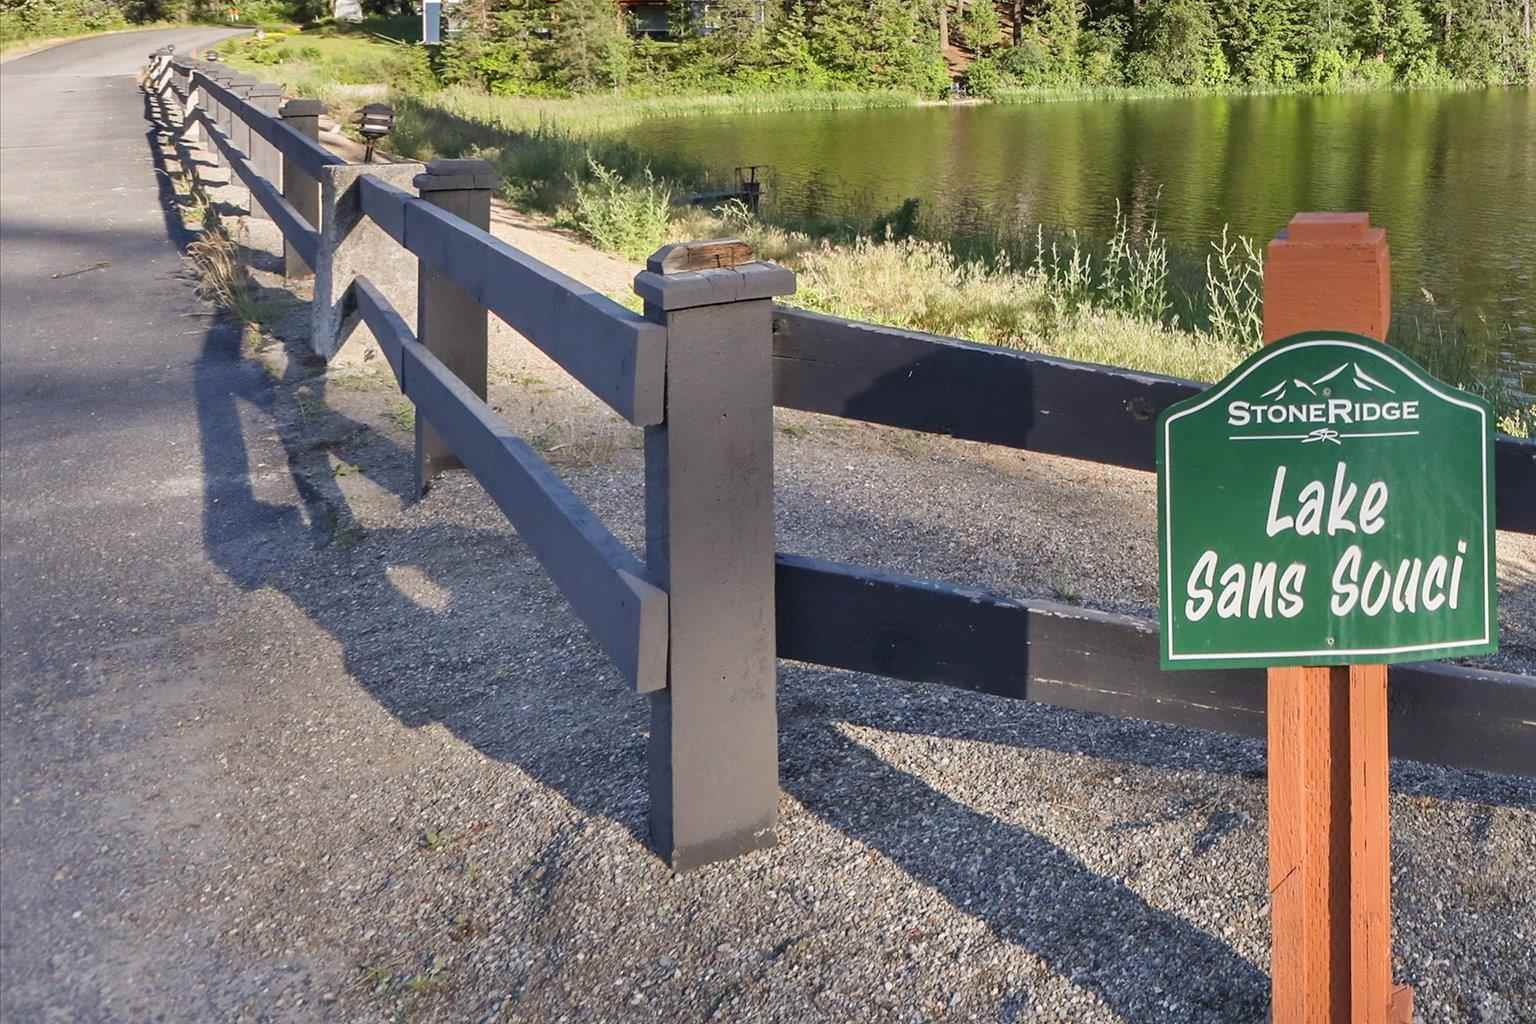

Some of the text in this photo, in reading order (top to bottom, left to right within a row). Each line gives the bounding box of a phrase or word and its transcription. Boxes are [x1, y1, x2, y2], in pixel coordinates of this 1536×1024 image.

[1265, 461, 1389, 538] Lake
[1184, 539, 1468, 622] Sans Souci
